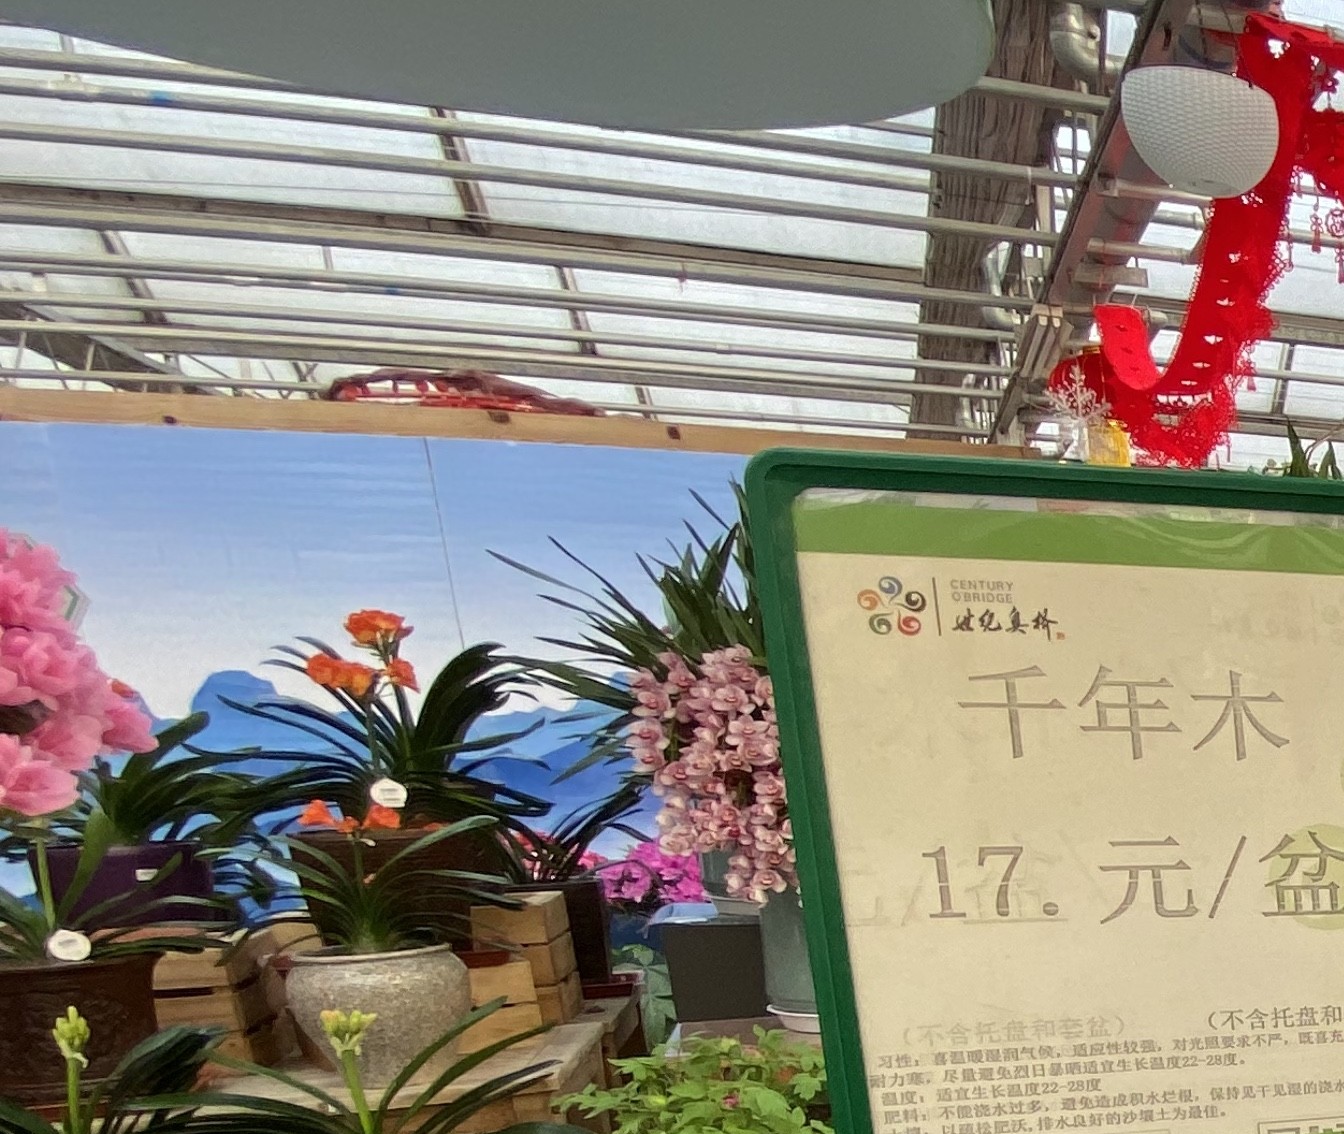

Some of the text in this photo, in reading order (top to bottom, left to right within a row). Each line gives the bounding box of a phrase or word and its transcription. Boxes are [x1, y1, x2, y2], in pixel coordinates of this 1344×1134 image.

[950, 579, 1014, 592] CENTURY
[957, 663, 1291, 762] 千年木
